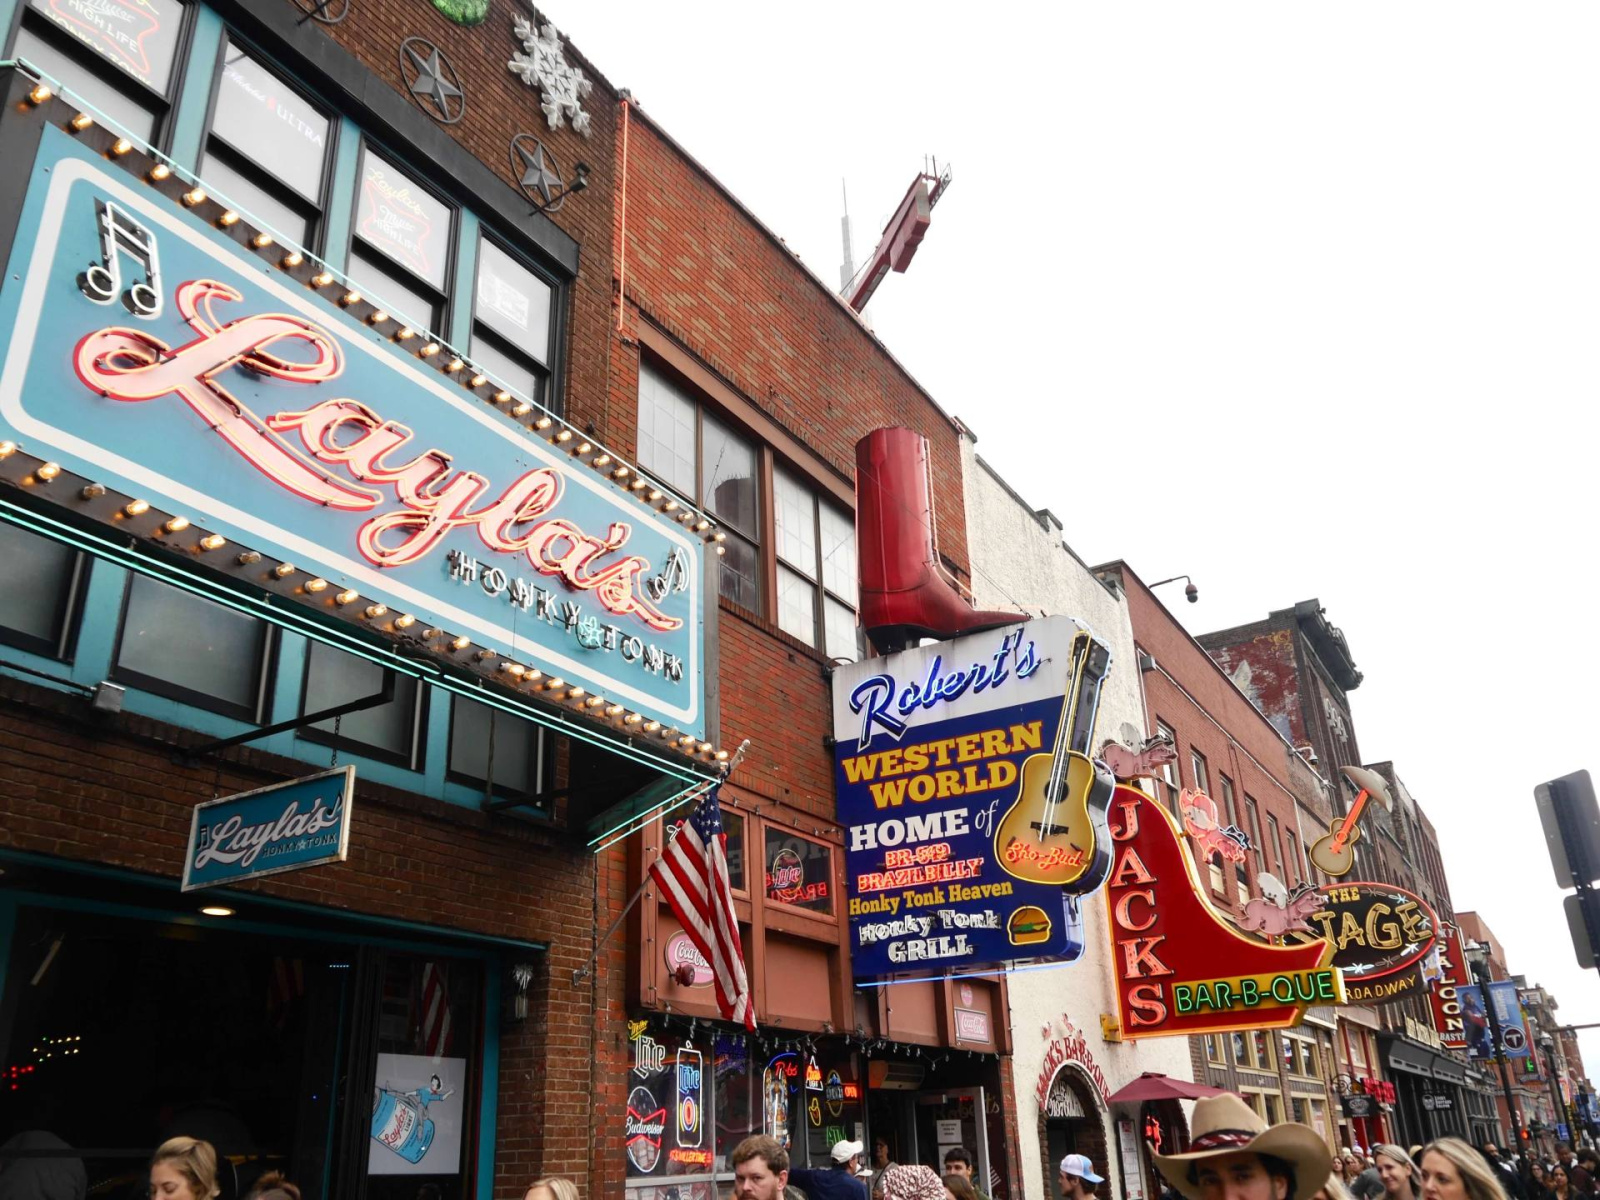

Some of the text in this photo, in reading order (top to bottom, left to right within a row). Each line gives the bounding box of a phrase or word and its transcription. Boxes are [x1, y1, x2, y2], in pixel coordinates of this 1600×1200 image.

[106, 24, 138, 53] LIFE
[277, 104, 323, 147] ULTRA
[72, 278, 684, 632] Layla's
[447, 549, 683, 685] HONKY TONK
[849, 627, 1043, 752] Robert's
[842, 720, 1043, 783] WESTERN
[869, 760, 1018, 810] WORLD
[195, 798, 339, 869] Layla's
[305, 833, 337, 850] TONK
[849, 799, 1000, 852] HOME of
[858, 858, 985, 892] BRAZILBILLY
[884, 842, 951, 870] BR-549
[1005, 841, 1083, 871] Sho-Bud
[849, 880, 1014, 916] Honky Tonk Heaven
[1110, 800, 1175, 1027] JACKS
[1328, 887, 1360, 904] THE
[859, 909, 1003, 945] Honky Tonk
[1292, 901, 1433, 951] TAGE
[887, 934, 974, 964] GRILL
[1175, 970, 1335, 1012] BAR-B-QUE
[1346, 975, 1416, 1000] ROADWAY
[1438, 940, 1463, 1031] SALOON
[633, 1035, 666, 1079] Lite
[678, 1064, 700, 1094] Lite
[844, 1086, 858, 1098] OPEN
[625, 1115, 665, 1136] Budweiser
